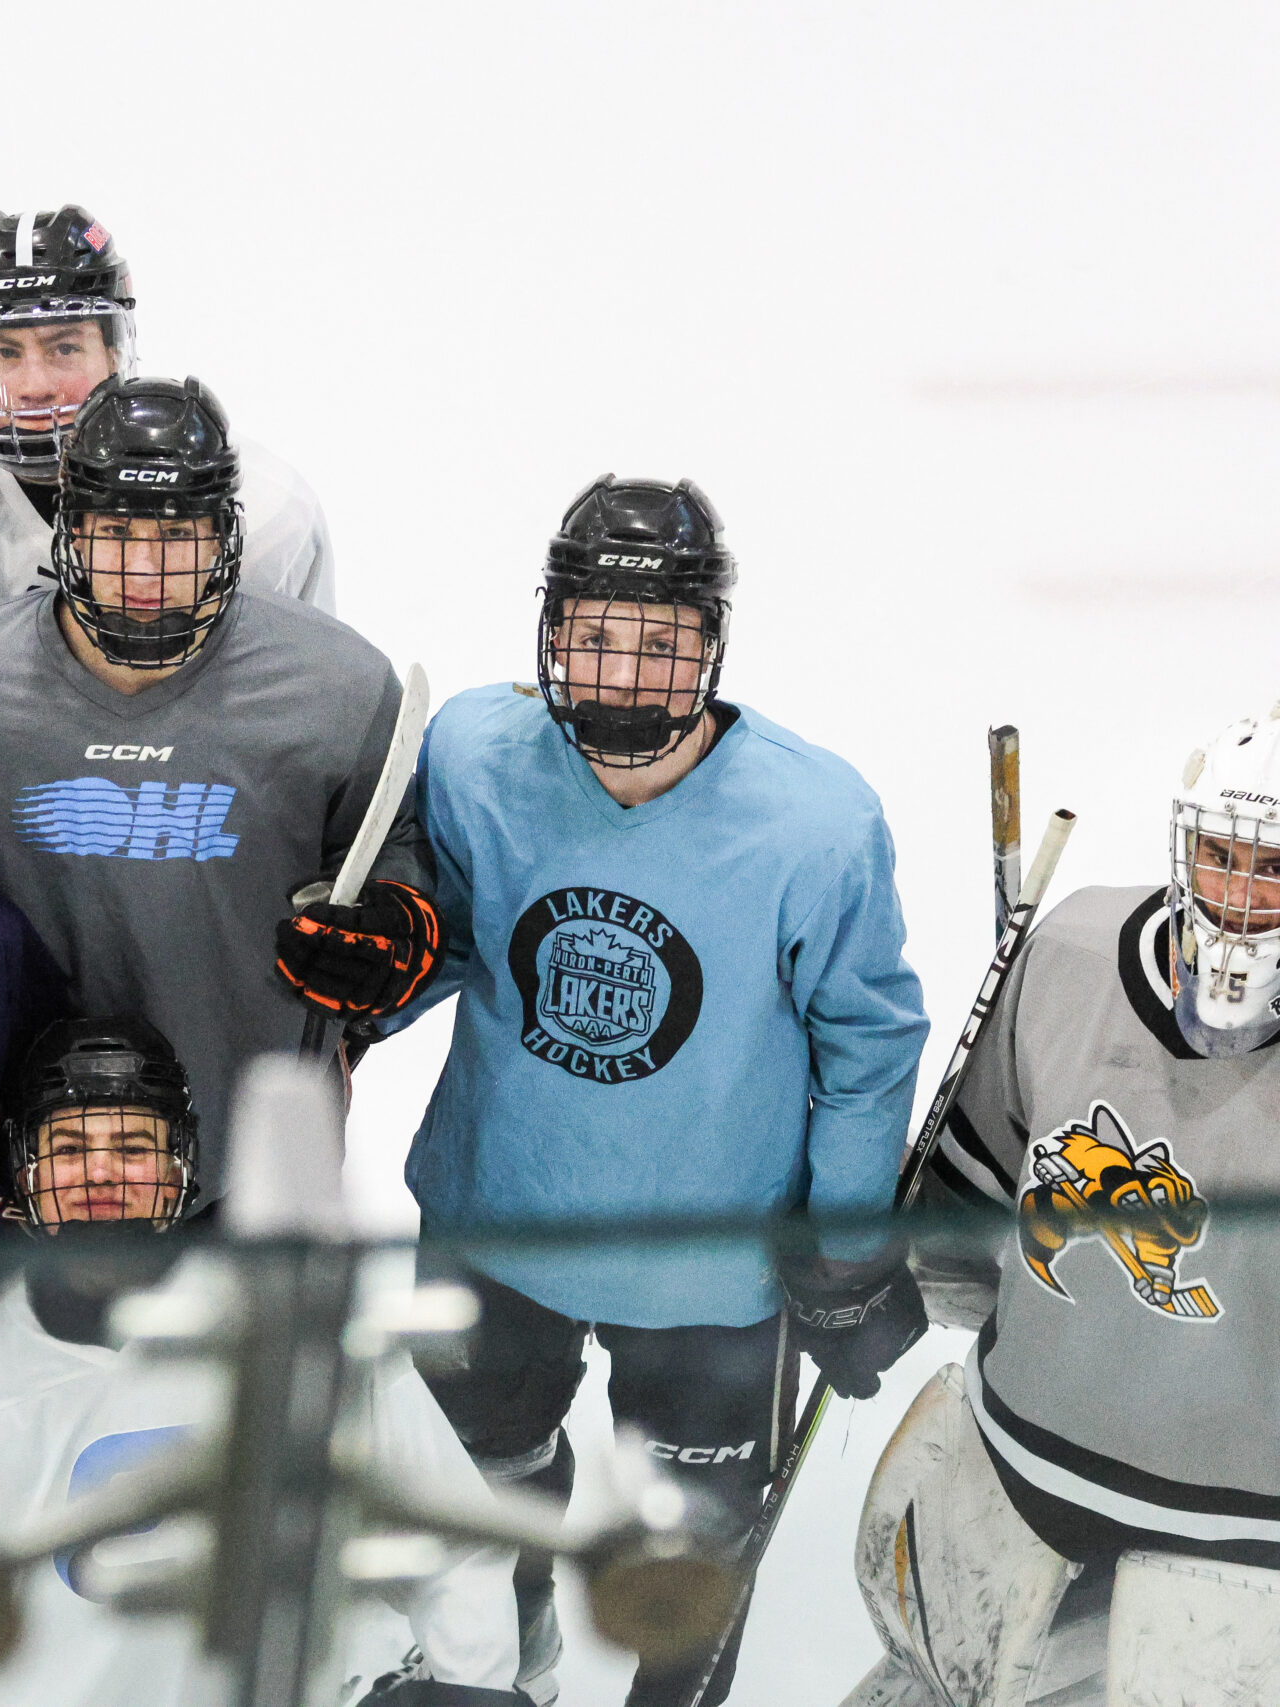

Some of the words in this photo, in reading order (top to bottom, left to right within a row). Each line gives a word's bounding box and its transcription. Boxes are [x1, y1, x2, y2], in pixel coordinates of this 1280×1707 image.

[118, 468, 180, 484] CCM
[597, 552, 664, 571] CCM
[83, 744, 175, 762] CCM
[11, 776, 241, 863] OHL
[545, 890, 674, 949] LAKERS
[553, 951, 651, 986] HURON-PERTH
[543, 967, 649, 1031] LAKERS
[571, 1019, 613, 1039] AAA
[523, 1027, 657, 1083] HOCKEY
[916, 1130, 930, 1153] FLEX
[644, 1440, 757, 1464] CCM
